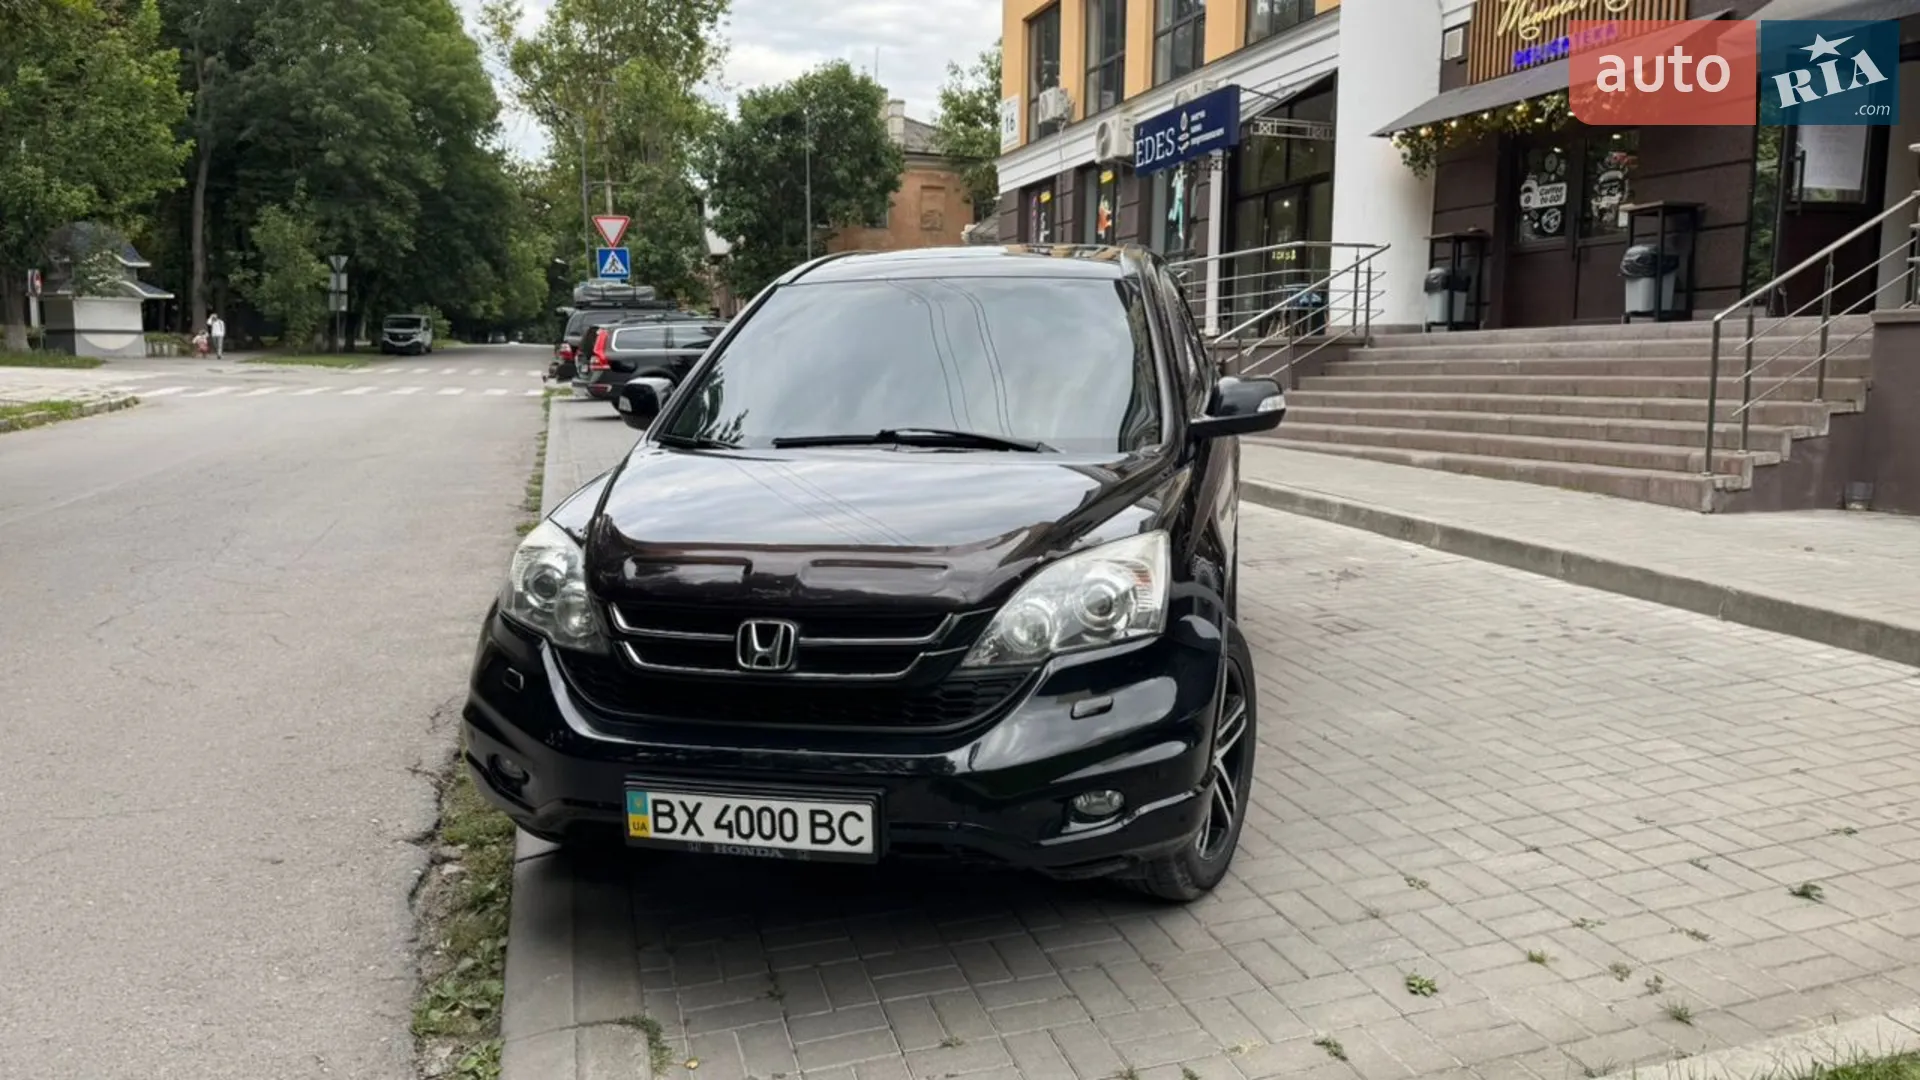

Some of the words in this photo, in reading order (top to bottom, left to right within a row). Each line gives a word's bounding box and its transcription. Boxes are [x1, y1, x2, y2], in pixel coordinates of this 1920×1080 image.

[632, 821, 648, 832] UA
[651, 799, 704, 837] BX
[714, 804, 799, 843] 4000
[809, 809, 865, 847] BC
[713, 843, 784, 859] HONDA
